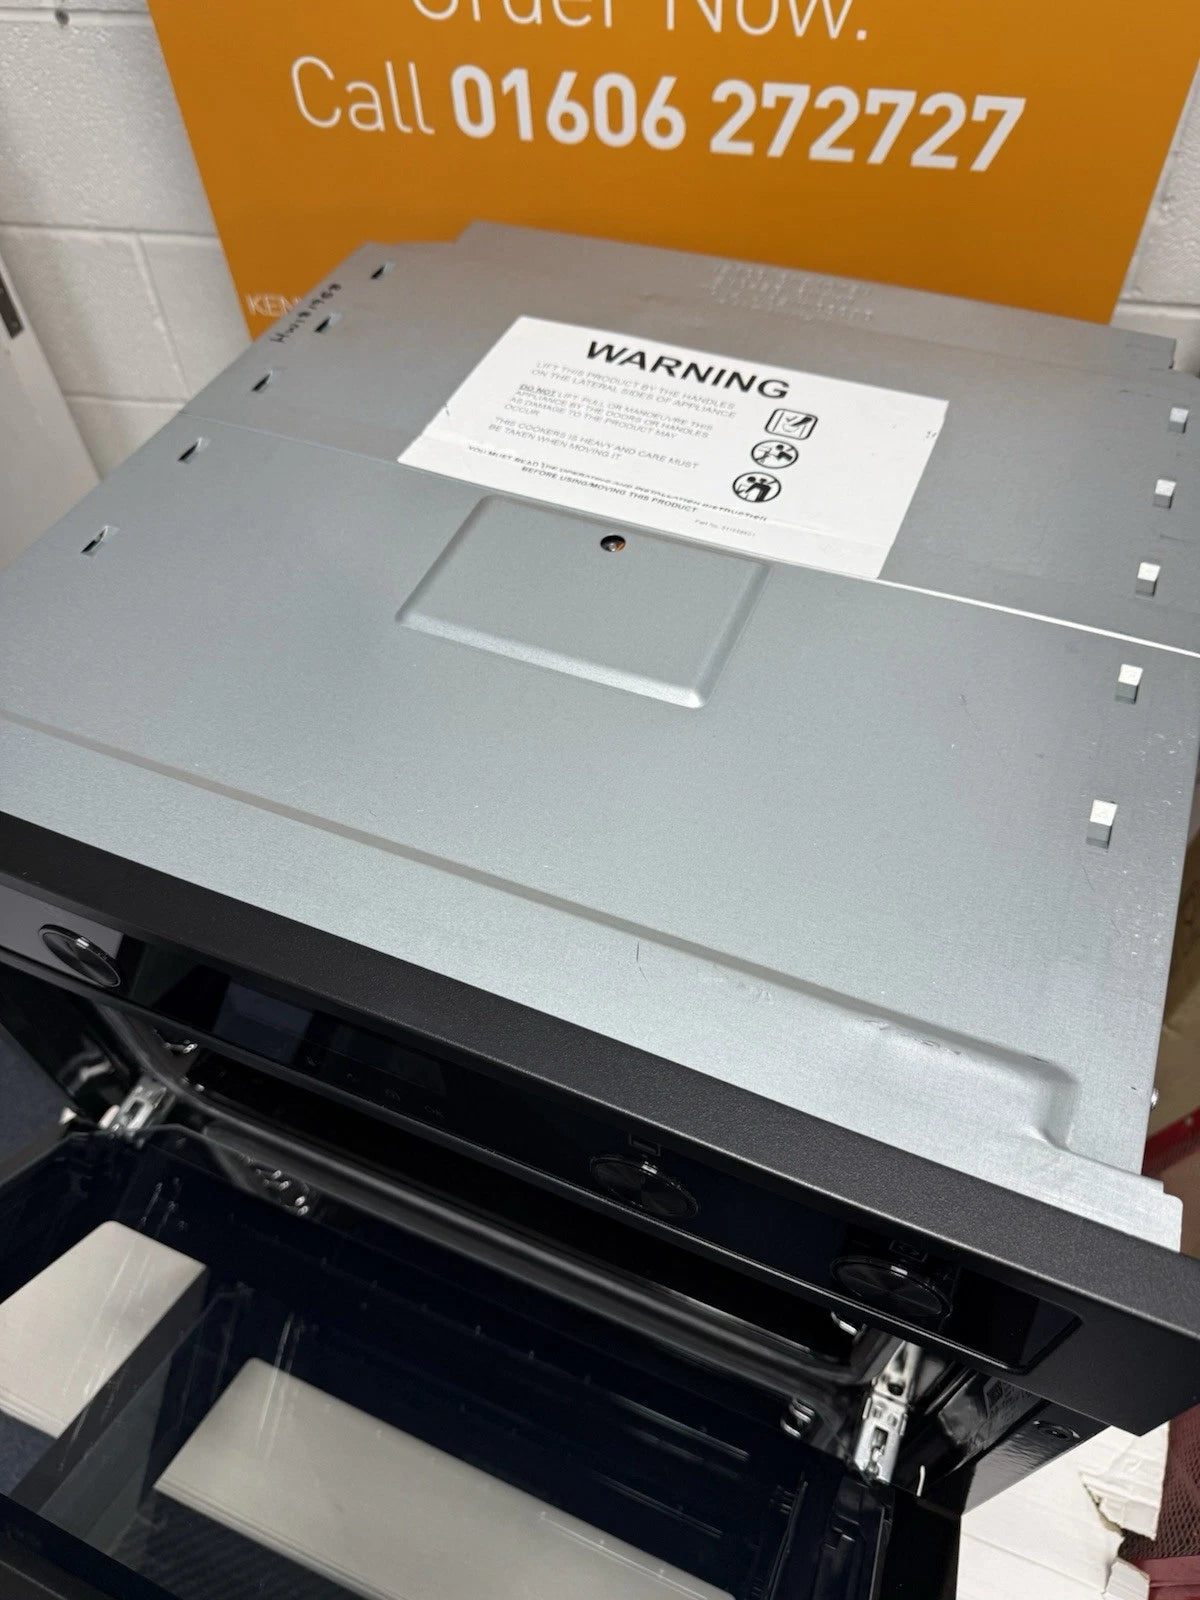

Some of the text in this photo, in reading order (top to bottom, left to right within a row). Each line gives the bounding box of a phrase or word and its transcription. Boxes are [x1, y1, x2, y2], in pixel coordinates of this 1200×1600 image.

[291, 56, 1027, 172] Call 01606 272727
[586, 340, 790, 399] WARNING
[586, 373, 638, 387] PRODUCT
[503, 428, 536, 439] TAKEN
[536, 435, 568, 447] WHEN
[569, 443, 610, 457] MOVING
[579, 437, 613, 448] HEAVY
[614, 445, 637, 454] AND
[638, 450, 666, 461] CARE
[668, 457, 698, 469] MUST
